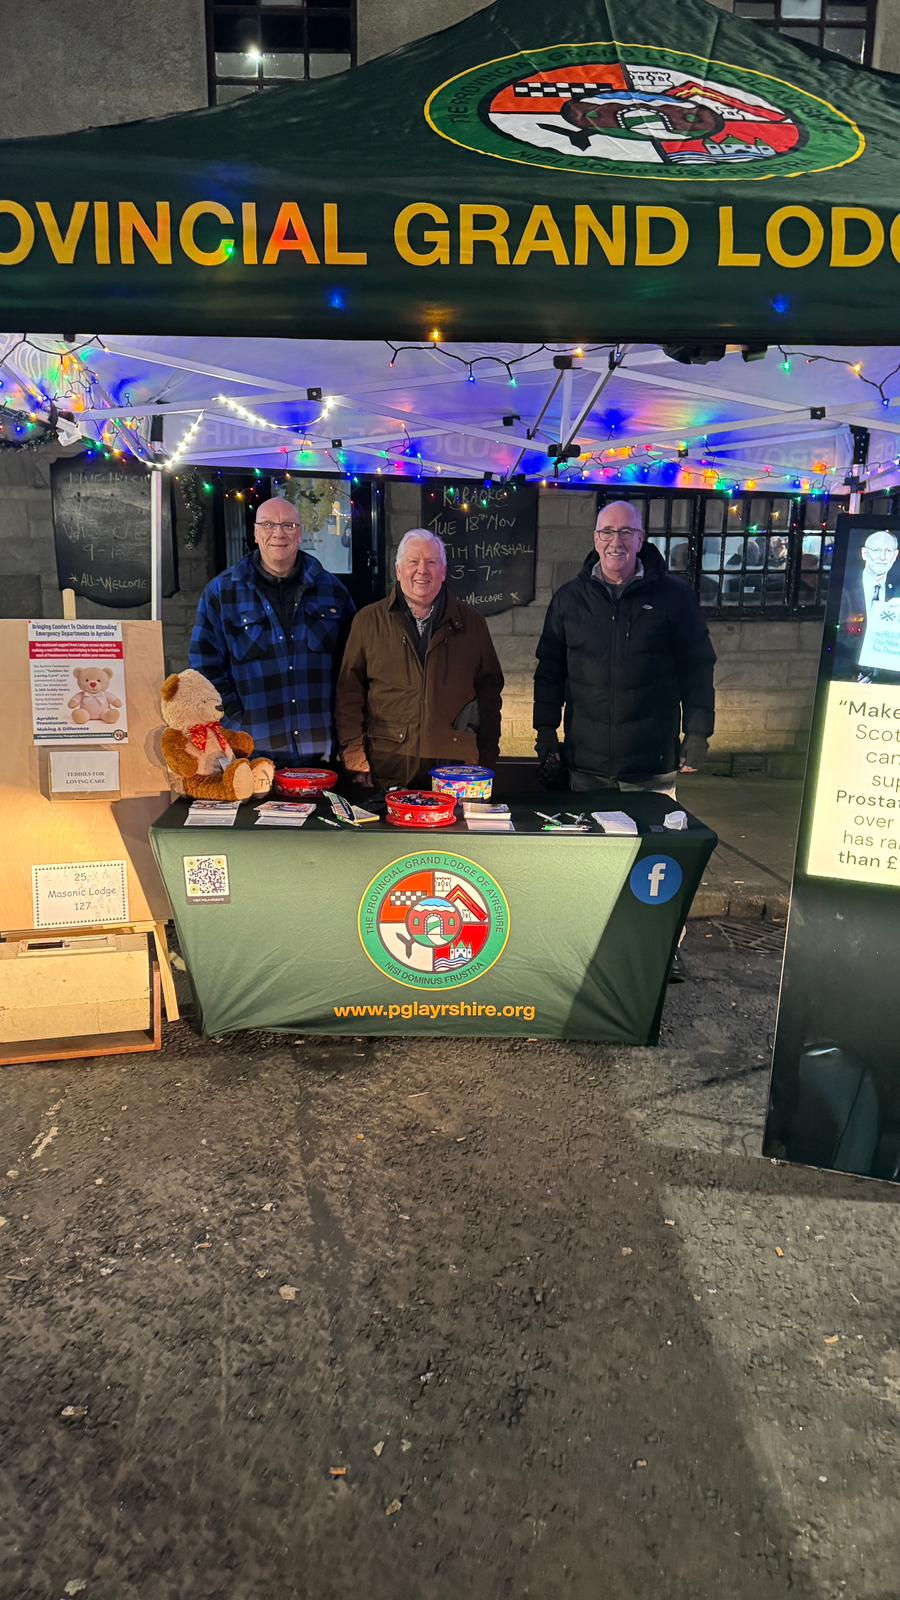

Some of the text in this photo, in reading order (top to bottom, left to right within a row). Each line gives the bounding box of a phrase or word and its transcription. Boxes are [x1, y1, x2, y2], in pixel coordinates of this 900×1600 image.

[547, 48, 635, 63] GRAND
[393, 202, 690, 267] GRAND
[718, 204, 900, 268] LOD
[428, 513, 457, 536] TUE
[474, 540, 534, 559] MARSHALL
[853, 815, 895, 828] over
[843, 829, 874, 847] has
[838, 850, 880, 868] than
[47, 886, 117, 899] Masonic Lodge
[365, 856, 505, 936] THE PROVINCIAL GRAND LODGE OF AYRSHIRE
[74, 901, 91, 911] 127
[384, 961, 485, 985] NISI DOMINUS FRUSTRA
[333, 1002, 536, 1021] www.pglayrshire.org
